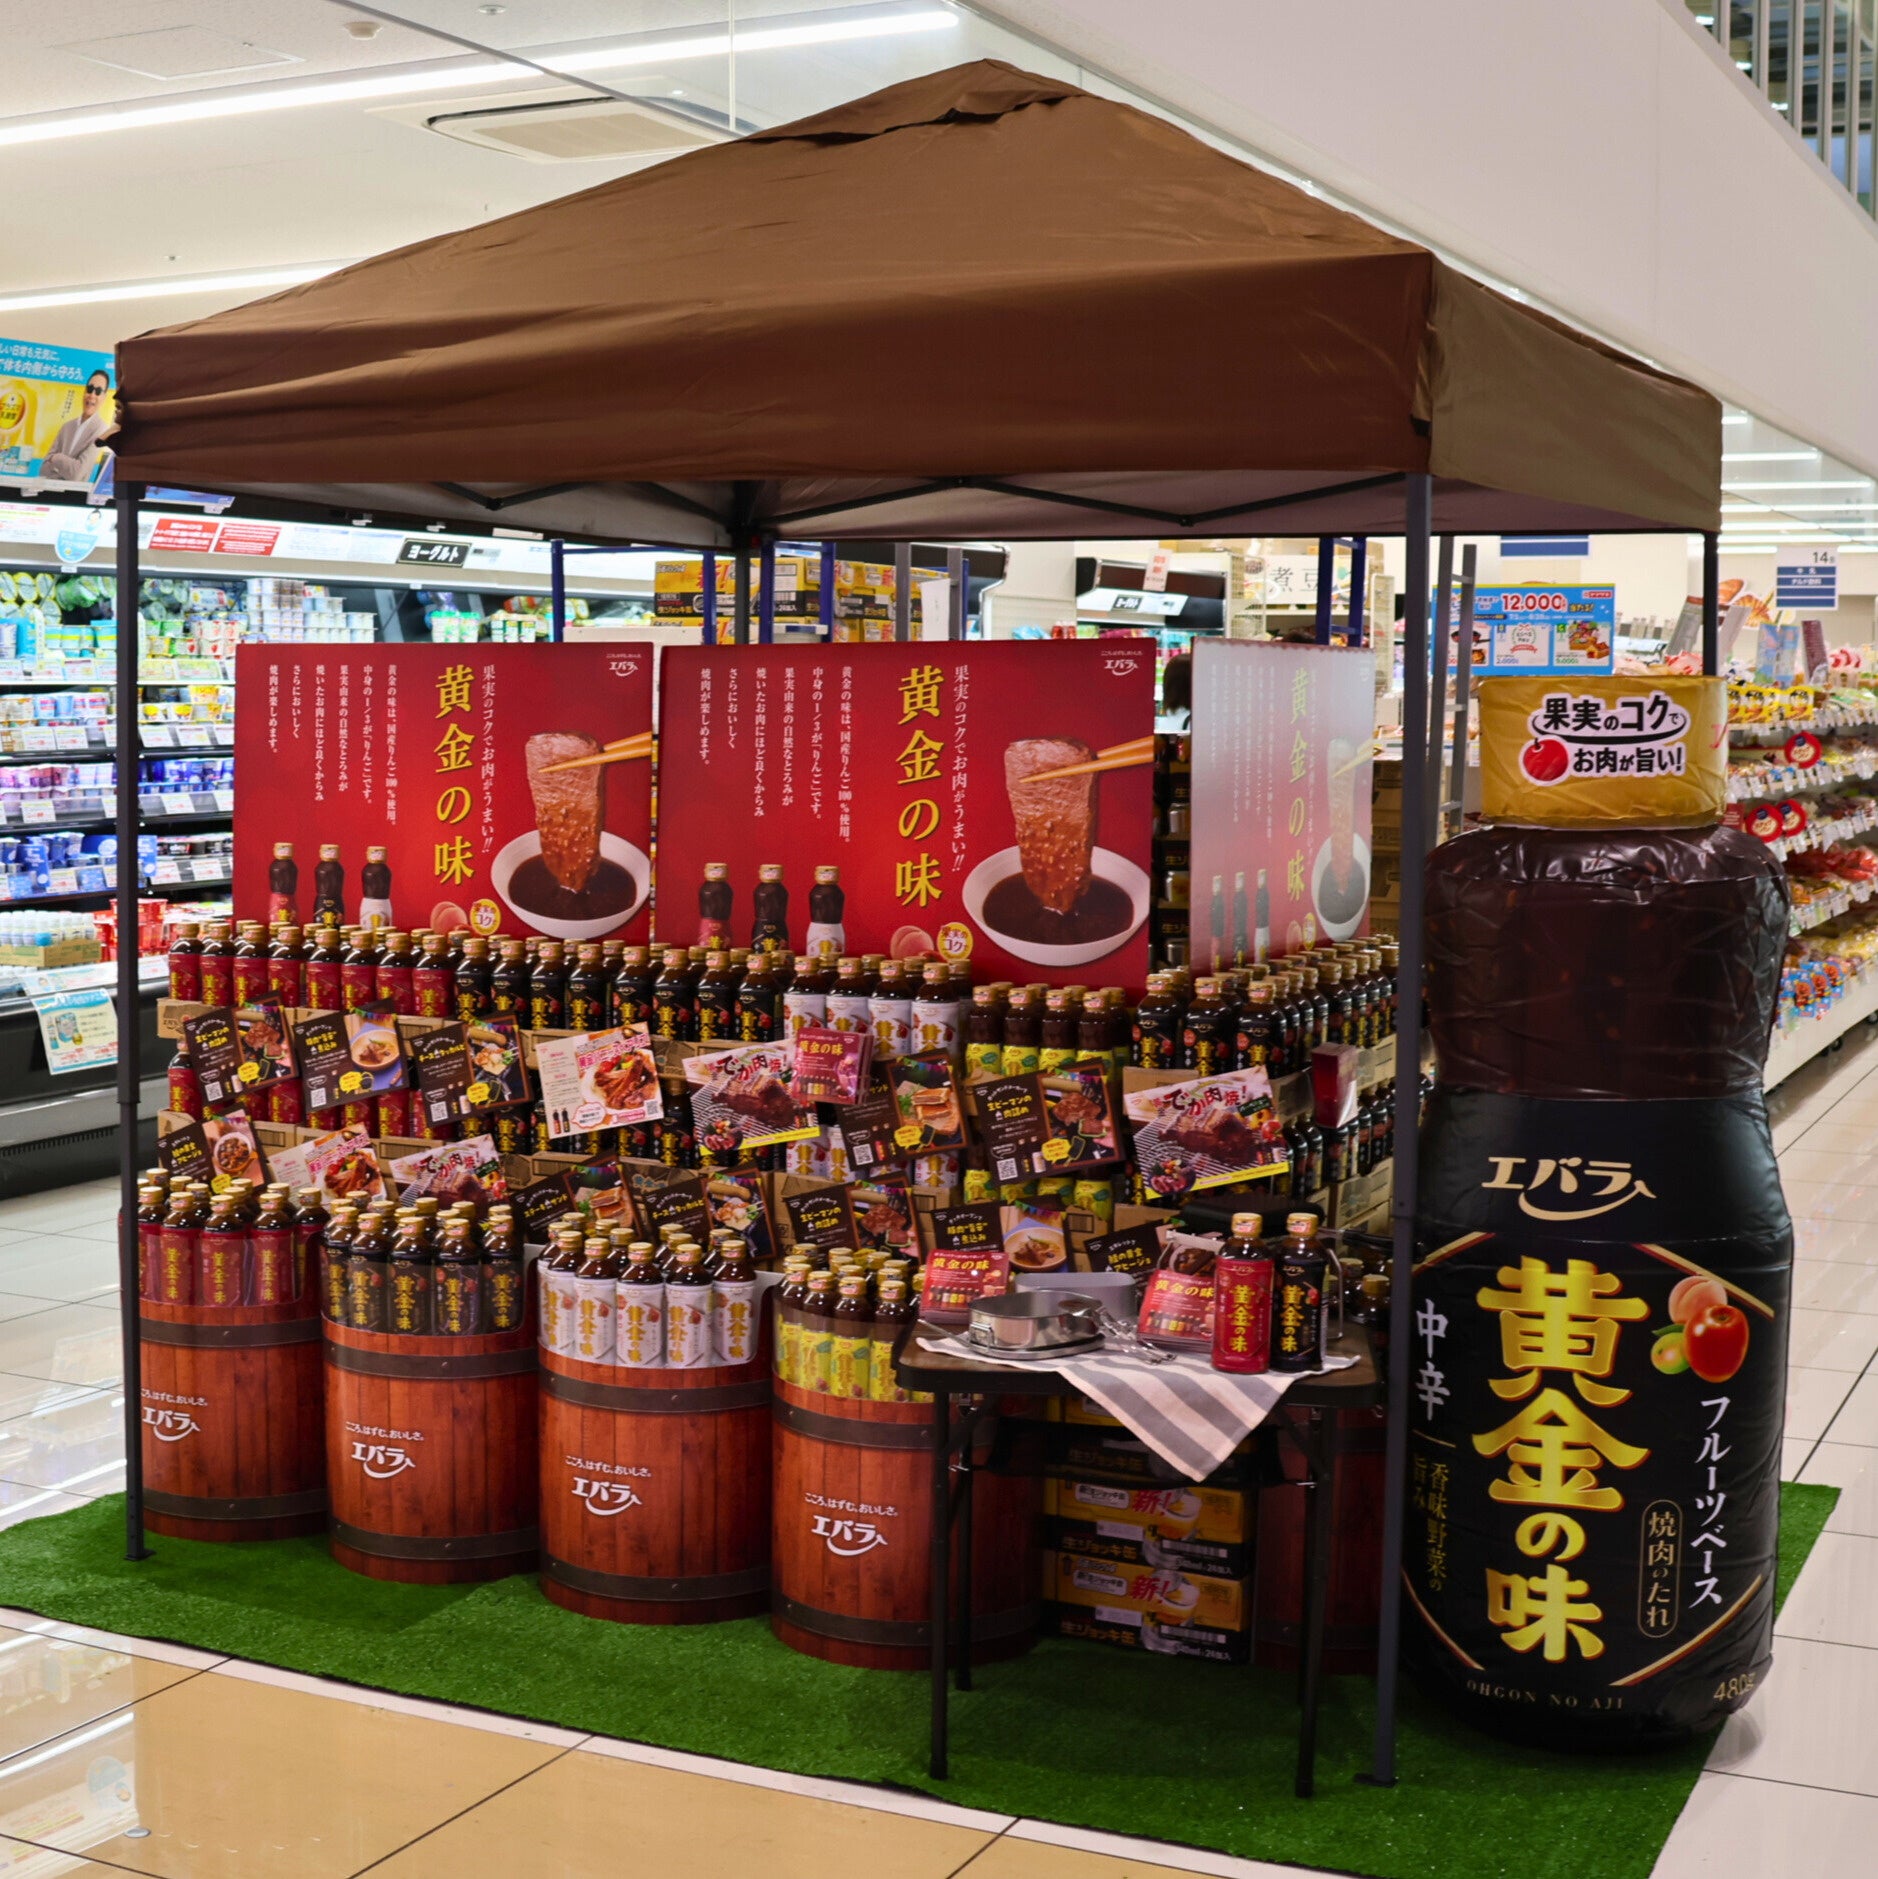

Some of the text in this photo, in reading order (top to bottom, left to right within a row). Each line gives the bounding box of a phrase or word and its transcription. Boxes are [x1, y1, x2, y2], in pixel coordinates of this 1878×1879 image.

[406, 543, 459, 564] ヨーグルト
[609, 661, 640, 677] エバラ
[1104, 658, 1139, 677] エバラ
[268, 664, 280, 753] 焼肉が楽しめます。
[291, 664, 303, 739] さらにおいしく
[314, 664, 326, 801] 焼いたお肉にほど良くからみ
[337, 664, 350, 792] 果実由来の自然なとろみが
[699, 667, 712, 766] 焼肉が楽しめます。
[727, 667, 739, 749] さらにおいしく
[1543, 694, 1680, 732] 果実のコクで
[754, 667, 767, 817] 焼いたお肉にほど良くからみ
[781, 667, 795, 807] 果実由来の自然なとろみが
[1572, 746, 1683, 773] お肉が旨い!
[433, 663, 475, 886] 黄金の味
[895, 664, 945, 908] 黄金の味
[1287, 667, 1309, 902] 黄金の味
[799, 1039, 844, 1056] 黄金の味
[1481, 1157, 1657, 1221] エバラ
[932, 1257, 990, 1270] 黄金の味
[1154, 1279, 1214, 1298] 黄金の味
[394, 1275, 416, 1331] 黄金の味
[443, 1277, 463, 1333] 黄金の味
[491, 1273, 513, 1329] 黄金の味
[1227, 1284, 1256, 1353] 黄金の味
[1280, 1284, 1305, 1353] 黄金の味
[1414, 1298, 1451, 1421] 中辛
[141, 1387, 208, 1407] ころ、はずむ、おいしさ。
[142, 1406, 201, 1442] エバラ
[351, 1441, 416, 1479] エバラ
[1471, 1255, 1652, 1662] 黄金の味
[571, 1477, 642, 1516] エバラ
[1426, 1462, 1450, 1592] 香味野菜の
[1688, 1396, 1732, 1609] フルーツベース
[811, 1514, 888, 1556] エバラ
[1646, 1510, 1677, 1628] 焼肉のたれ
[1549, 1692, 1579, 1707] NO
[1593, 1696, 1624, 1710] AJI
